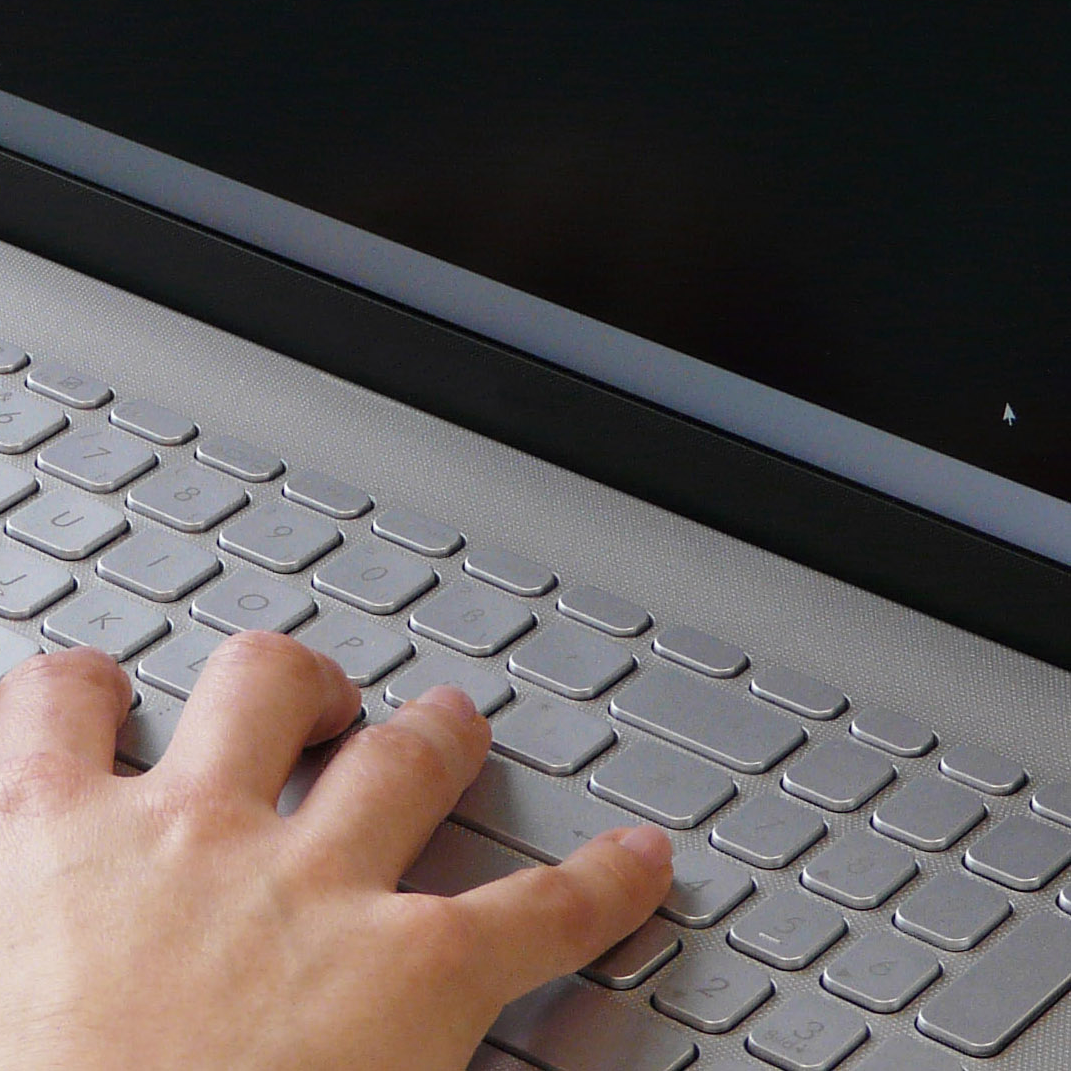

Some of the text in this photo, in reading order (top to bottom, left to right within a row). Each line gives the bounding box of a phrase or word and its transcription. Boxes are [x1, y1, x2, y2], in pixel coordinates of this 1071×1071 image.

[82, 446, 113, 459] 7
[174, 487, 201, 502] 8
[51, 510, 85, 527] U
[265, 525, 294, 538] 9
[147, 555, 170, 568] I
[0, 573, 27, 587] J
[88, 611, 123, 630] K
[335, 637, 364, 649] P
[696, 977, 730, 998] 2
[794, 1021, 825, 1040] 3
